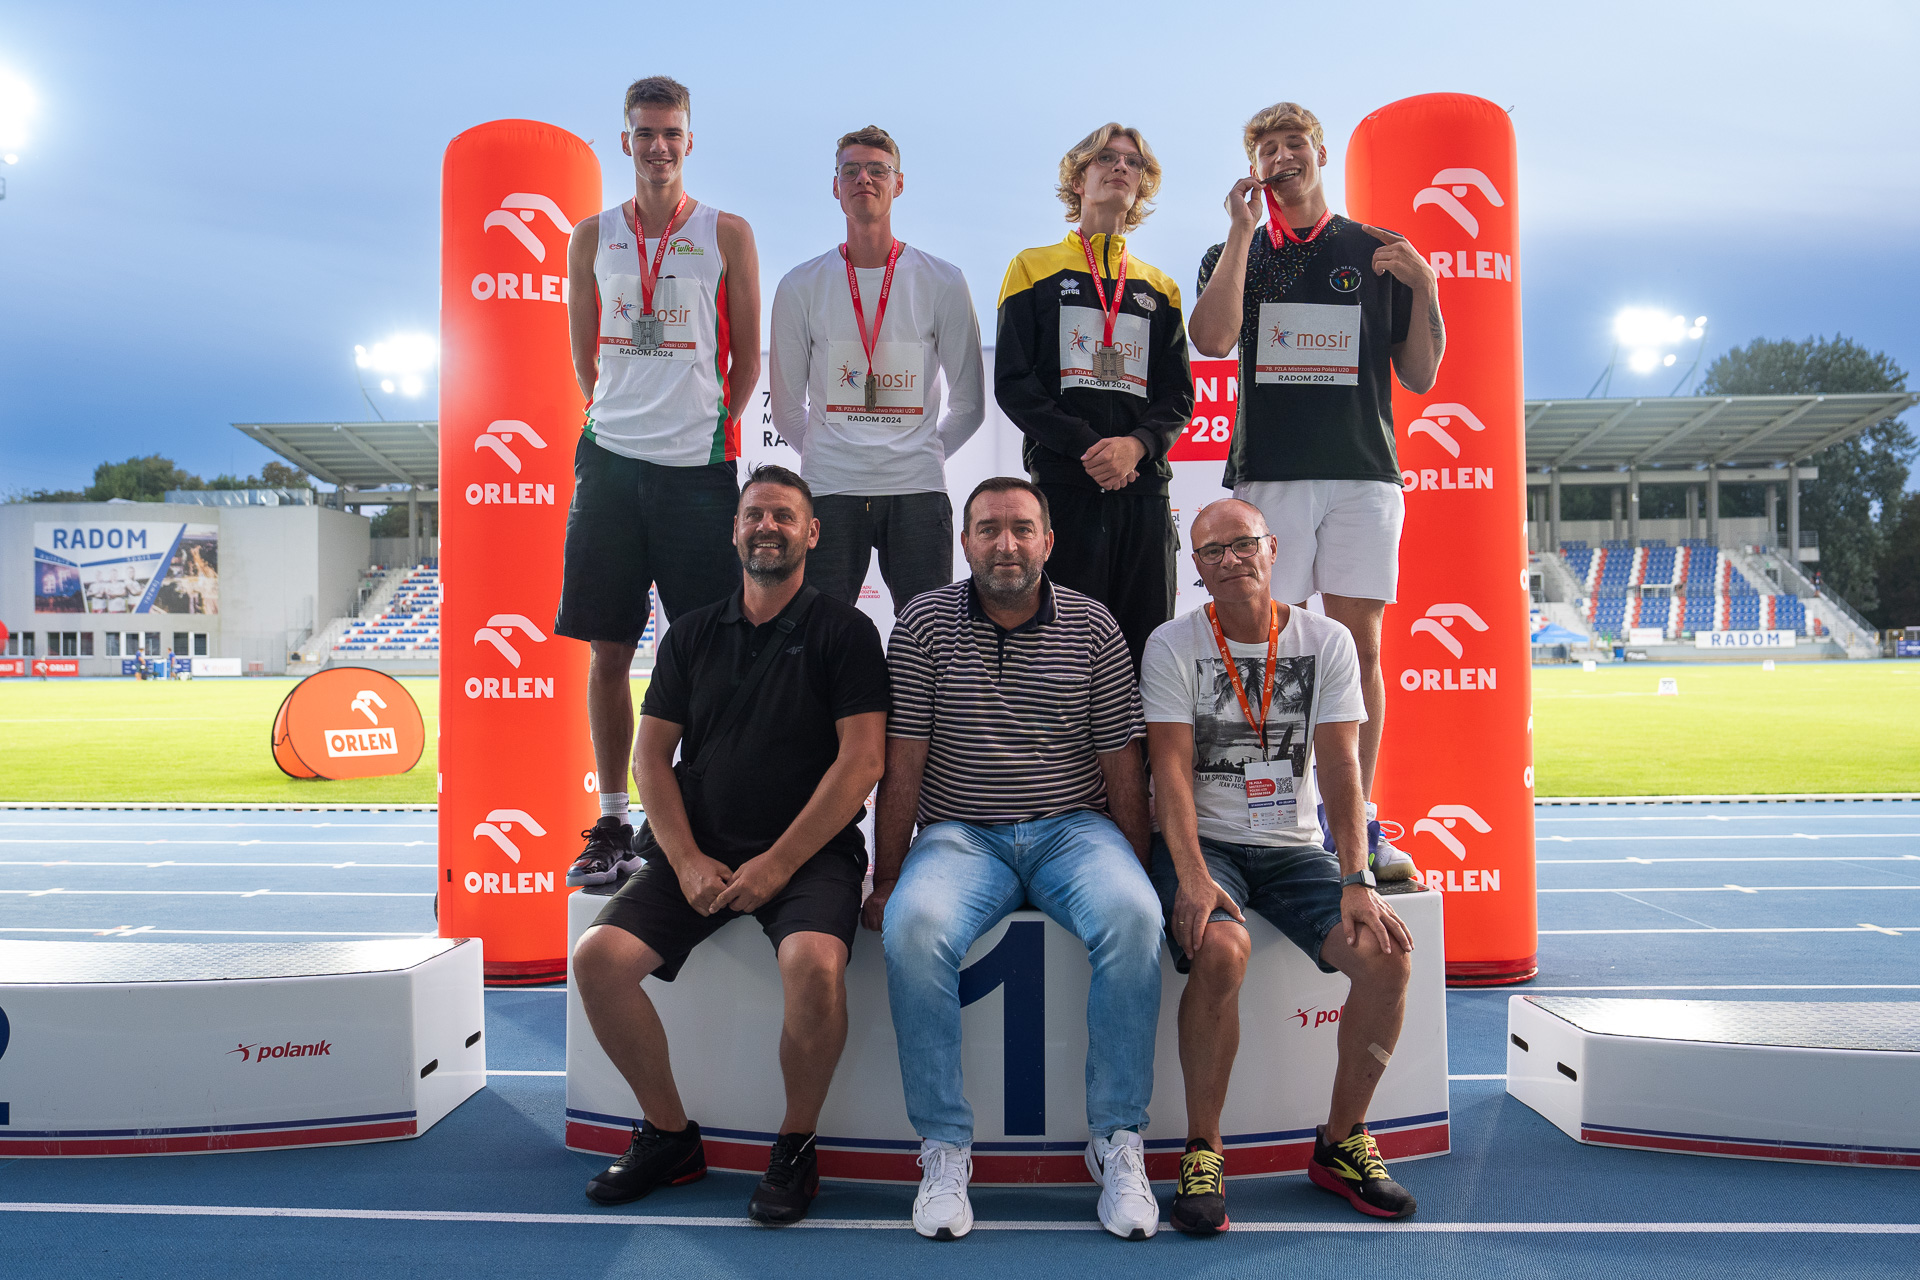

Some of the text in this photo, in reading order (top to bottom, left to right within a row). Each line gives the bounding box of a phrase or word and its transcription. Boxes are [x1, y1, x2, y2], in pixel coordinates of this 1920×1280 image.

[1424, 250, 1512, 282] RLEN
[1296, 330, 1352, 348] mosir
[619, 347, 651, 356] RADOM
[1078, 378, 1131, 390] RADOM 2024
[881, 416, 902, 424] 2024
[1402, 467, 1493, 492] ORLEN
[465, 482, 555, 505] ORLEN
[53, 528, 147, 549] RADOM
[1710, 632, 1780, 646] RADOM
[464, 677, 554, 699] ORLEN
[1400, 667, 1497, 691] ORLEN
[331, 733, 392, 753] ORLEN
[464, 871, 554, 894] ORLEN
[959, 920, 1045, 1137] 1
[256, 1039, 332, 1063] polanik
